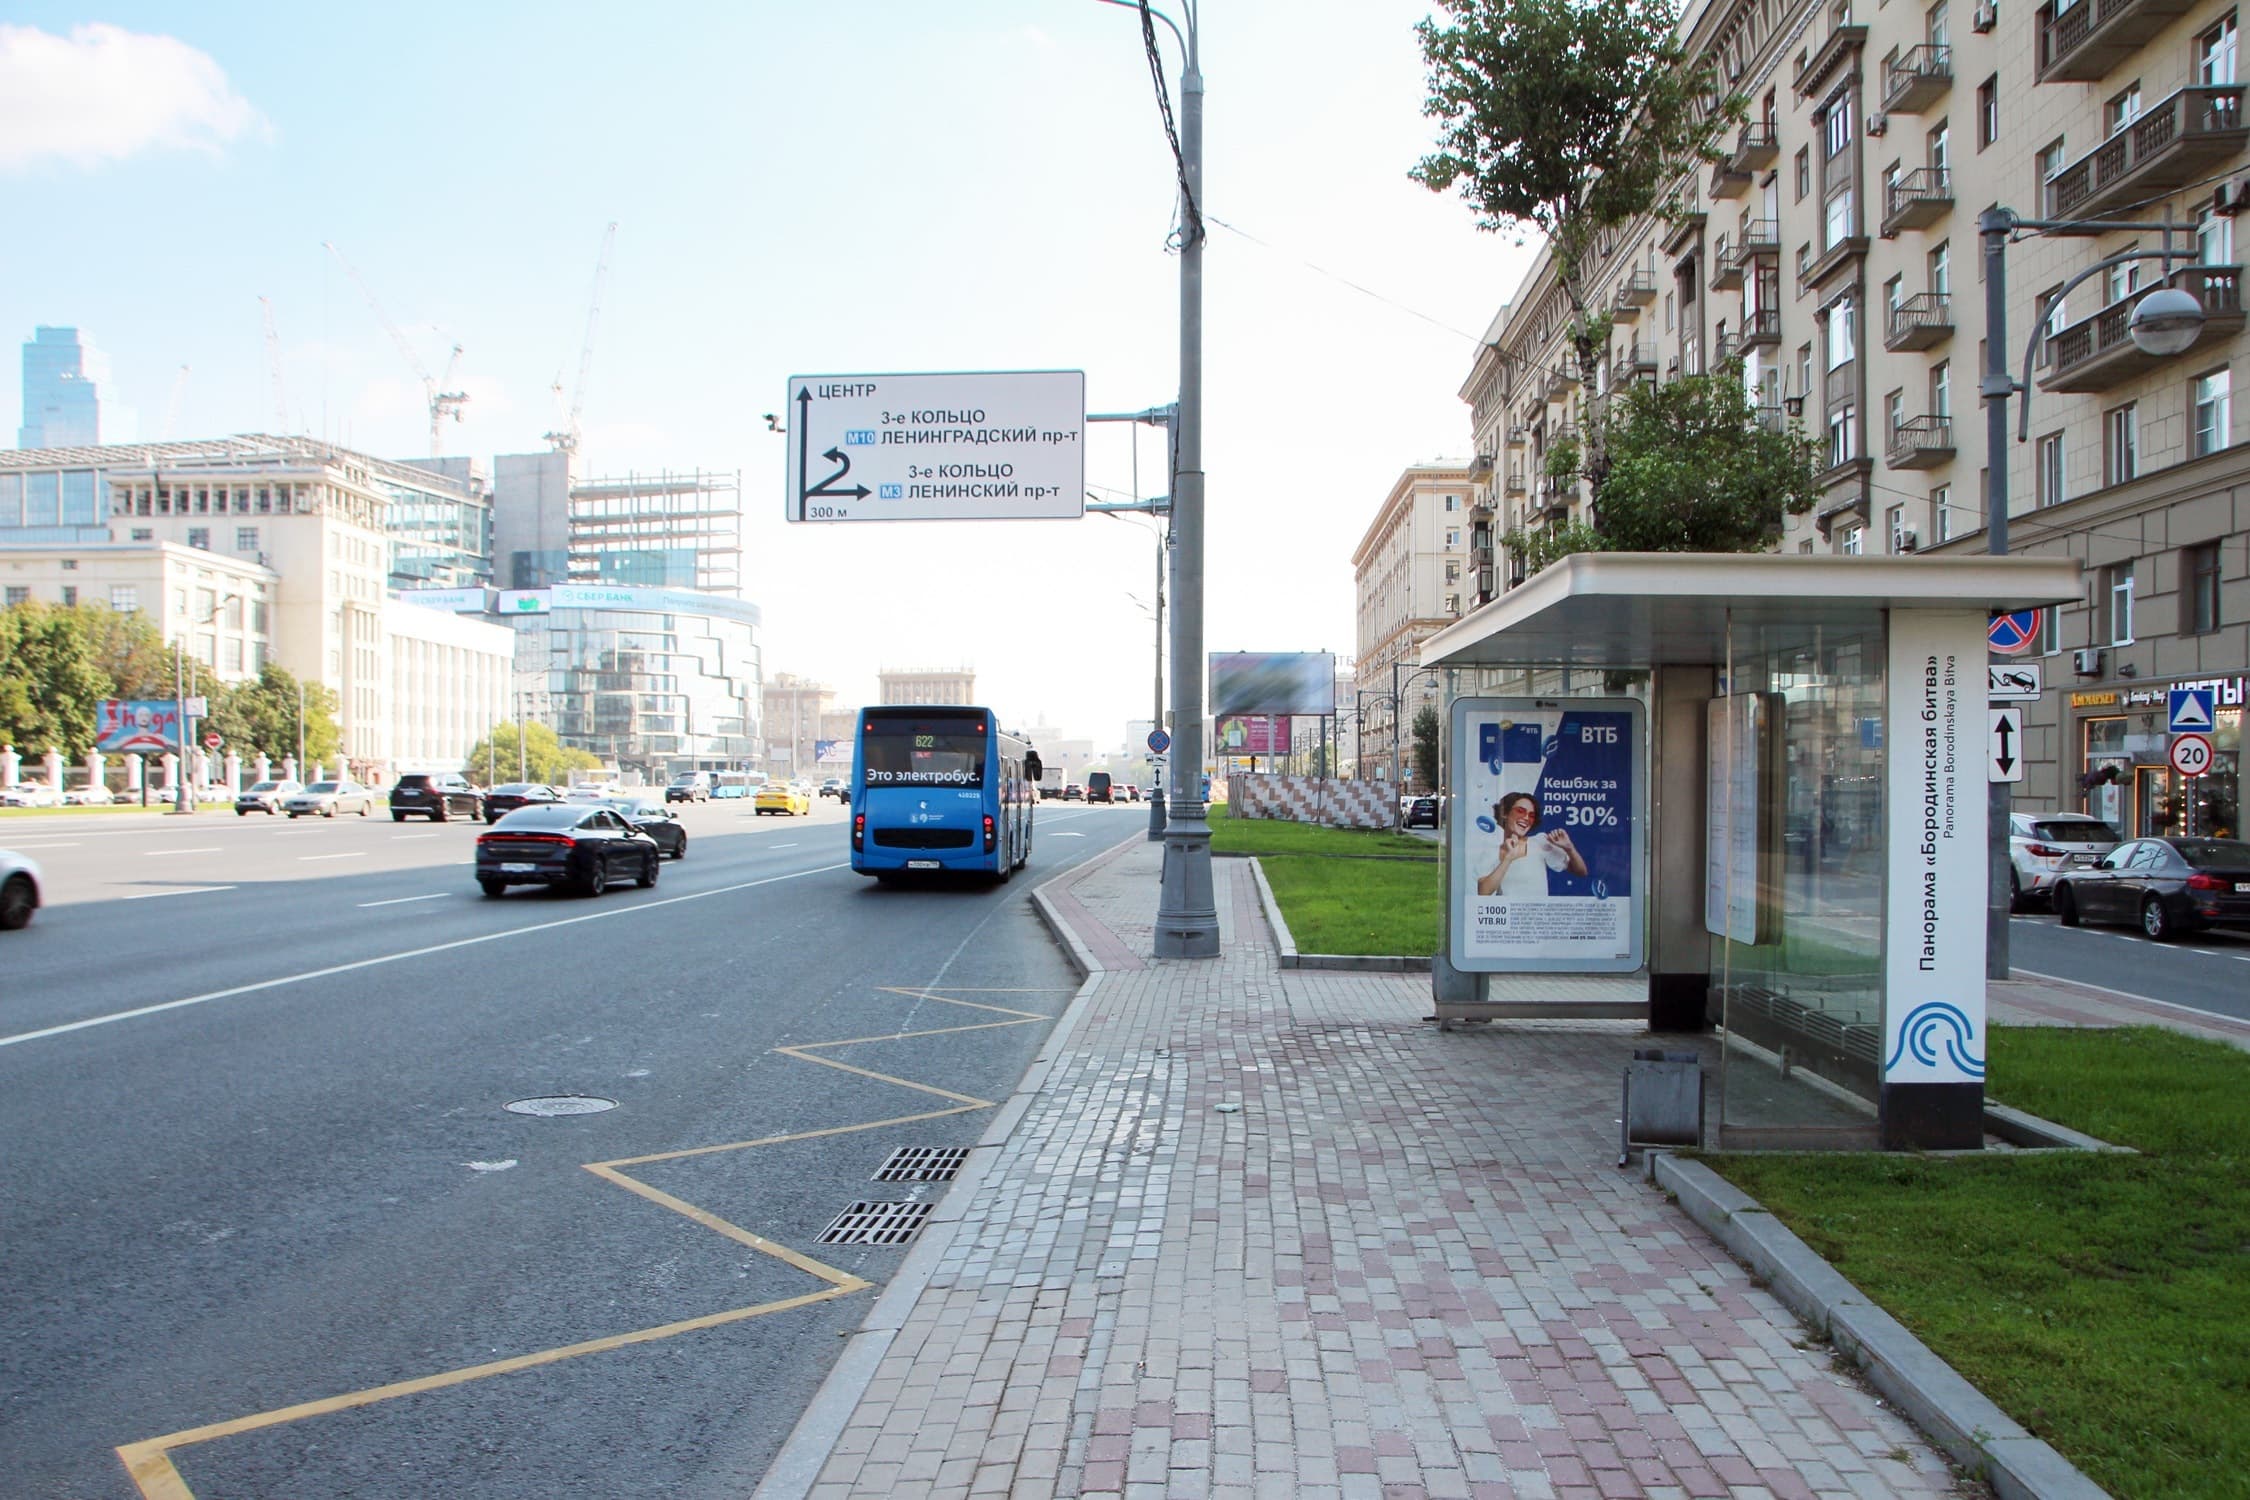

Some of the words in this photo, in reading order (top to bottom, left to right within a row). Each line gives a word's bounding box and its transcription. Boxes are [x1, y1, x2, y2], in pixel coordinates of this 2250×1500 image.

[818, 383, 877, 400] ЦЕНТР
[880, 411, 906, 425] 3-е
[911, 409, 986, 427] КОЛЬЦО
[847, 432, 875, 445] М10
[880, 425, 1037, 446] ЛЕНИНГРАДСКИЙ
[1042, 430, 1078, 446] пр-т
[908, 466, 934, 479] 3-е
[938, 464, 1014, 481] КОЛЬЦО
[880, 486, 902, 499] М3
[908, 482, 1019, 500] ЛЕНИНСКИЙ
[1024, 486, 1060, 501] пр-т
[811, 507, 833, 518] 300
[838, 510, 848, 518] м
[1944, 655, 1955, 686] Bitva
[1921, 656, 1938, 721] битва»
[1581, 727, 1618, 743] ВТБ
[1944, 690, 1957, 773] Borodinskaya
[915, 735, 934, 747] 622
[2180, 748, 2204, 764] 20
[867, 768, 893, 781] Это
[896, 769, 980, 784] электробус.
[1544, 777, 1599, 789] Кешбэк
[1601, 780, 1617, 789] за
[1544, 792, 1606, 803] покупки
[1921, 727, 1939, 866] «Бородинская
[1543, 805, 1562, 816] до
[1565, 807, 1618, 826] 30%
[1943, 777, 1955, 839] Panorama
[1485, 906, 1507, 915] 1000
[1478, 917, 1507, 926] VTB.RU
[1919, 872, 1939, 971] Панорама
